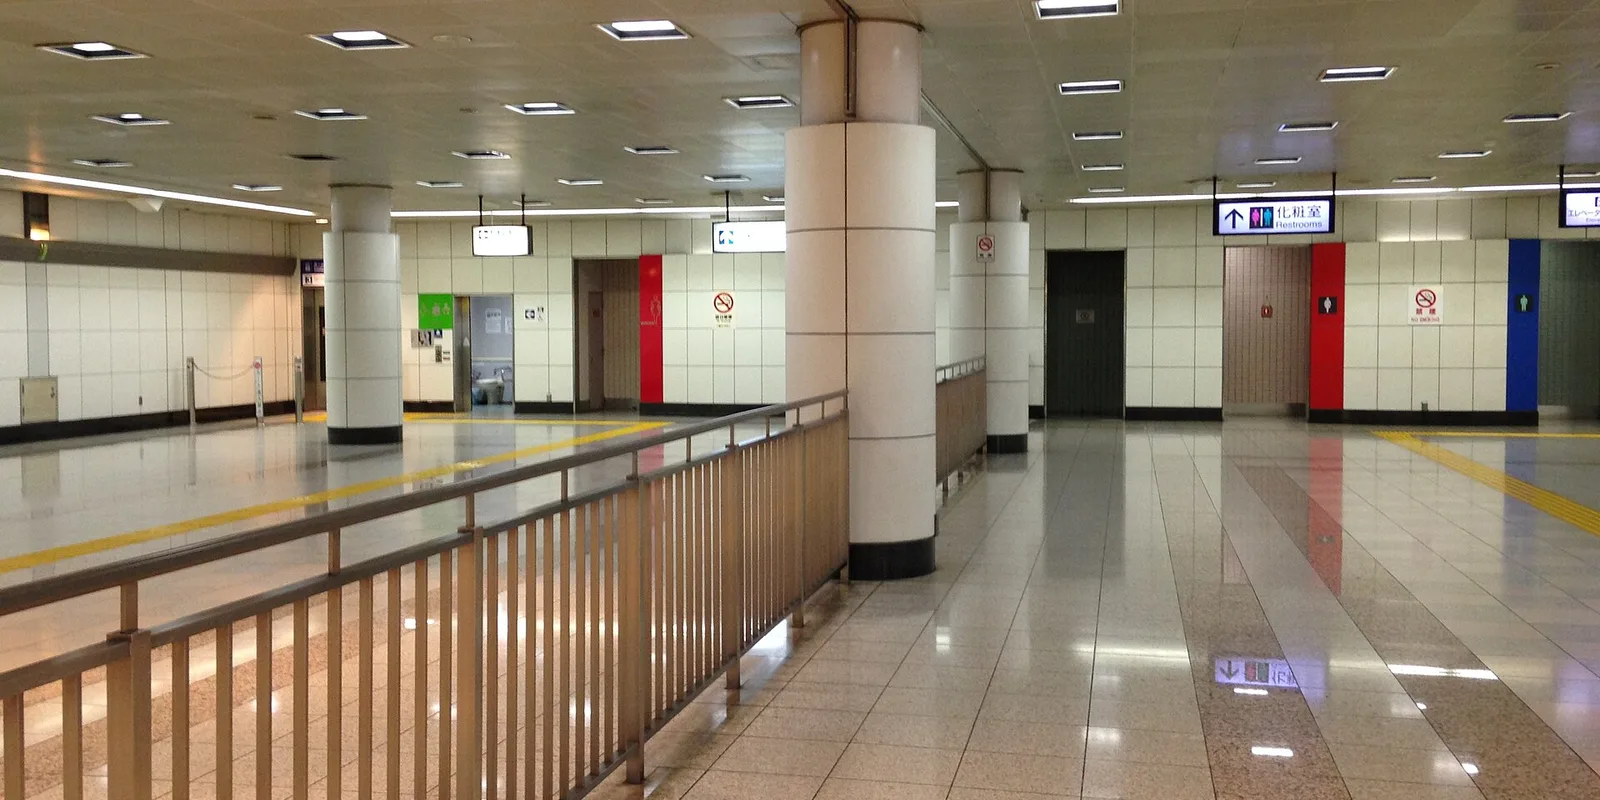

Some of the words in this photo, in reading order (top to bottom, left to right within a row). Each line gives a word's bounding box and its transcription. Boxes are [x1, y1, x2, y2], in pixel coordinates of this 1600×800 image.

[1277, 205, 1321, 218] 化粧室
[1276, 220, 1323, 229] Restrooms
